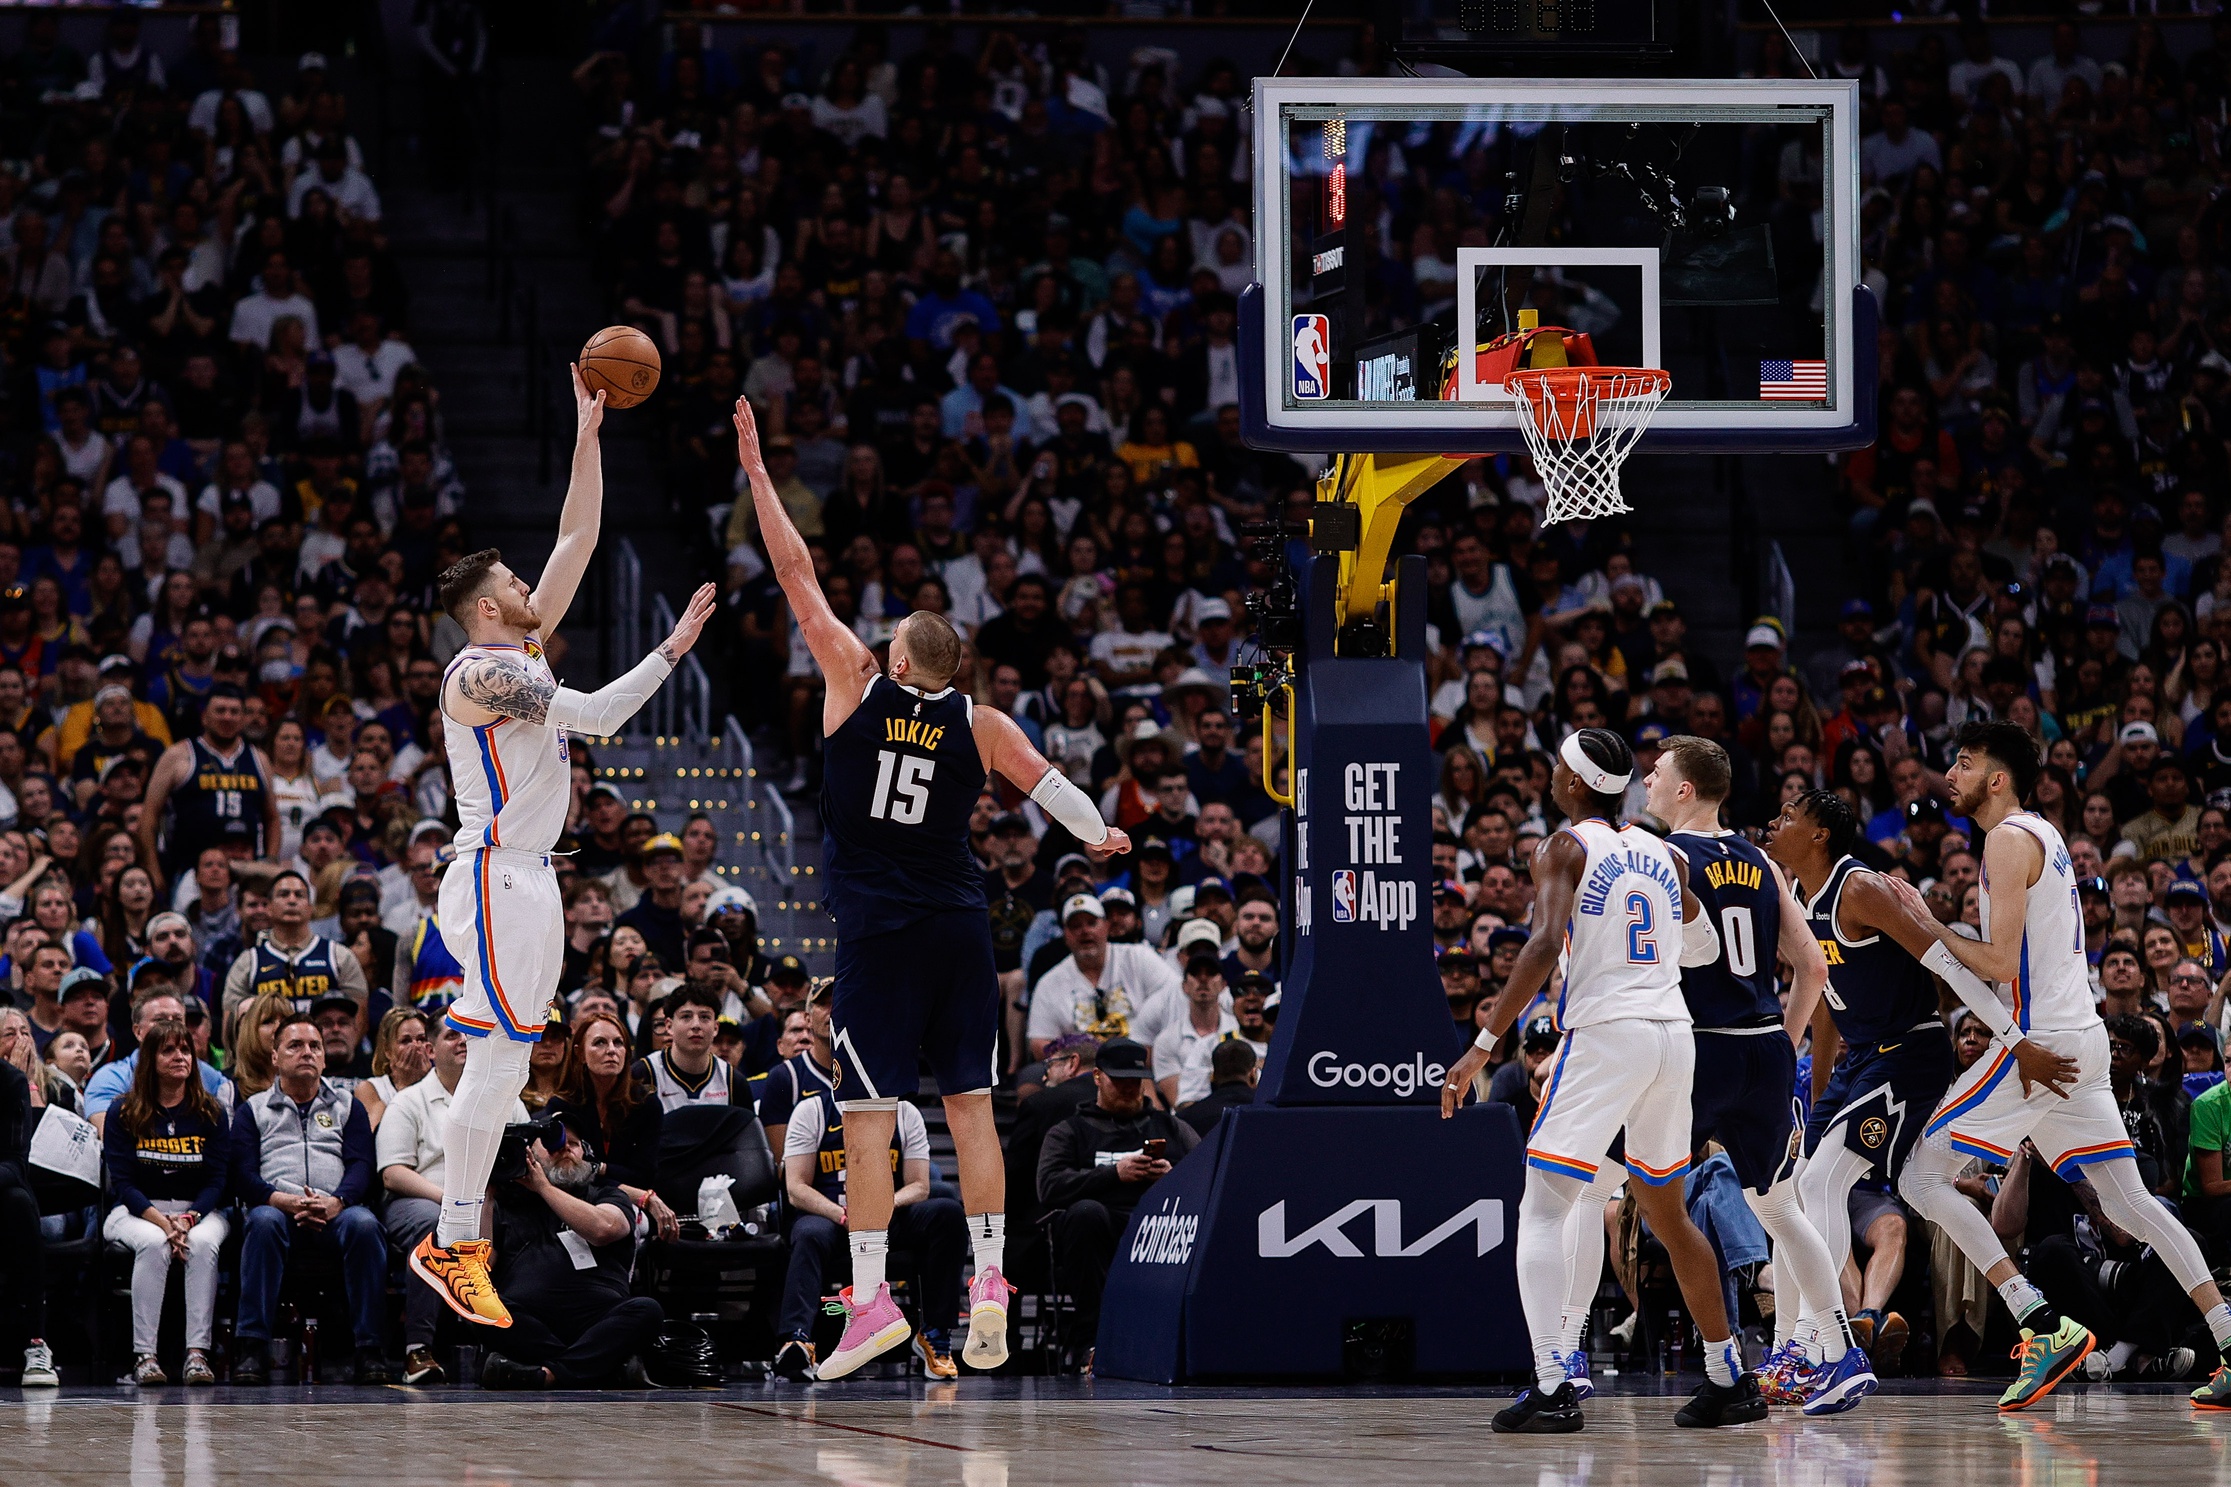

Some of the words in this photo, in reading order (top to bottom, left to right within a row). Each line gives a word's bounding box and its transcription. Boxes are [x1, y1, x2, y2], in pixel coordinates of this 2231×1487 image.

[1298, 380, 1316, 394] NBA
[885, 717, 946, 751] JOKIĆ
[870, 749, 936, 825] 15
[1344, 762, 1400, 811] GET
[1344, 816, 1402, 864] THE
[1360, 871, 1417, 931] App
[1580, 850, 1683, 921] GILGEOUS-ALEXANDER
[1704, 860, 1763, 890] BRAUN
[1624, 890, 1660, 965] 2
[1721, 906, 1757, 977] 0
[2070, 884, 2083, 954] 7
[1308, 1051, 1446, 1097] Google
[1130, 1196, 1199, 1264] coinbase
[1258, 1199, 1504, 1258] KIA
